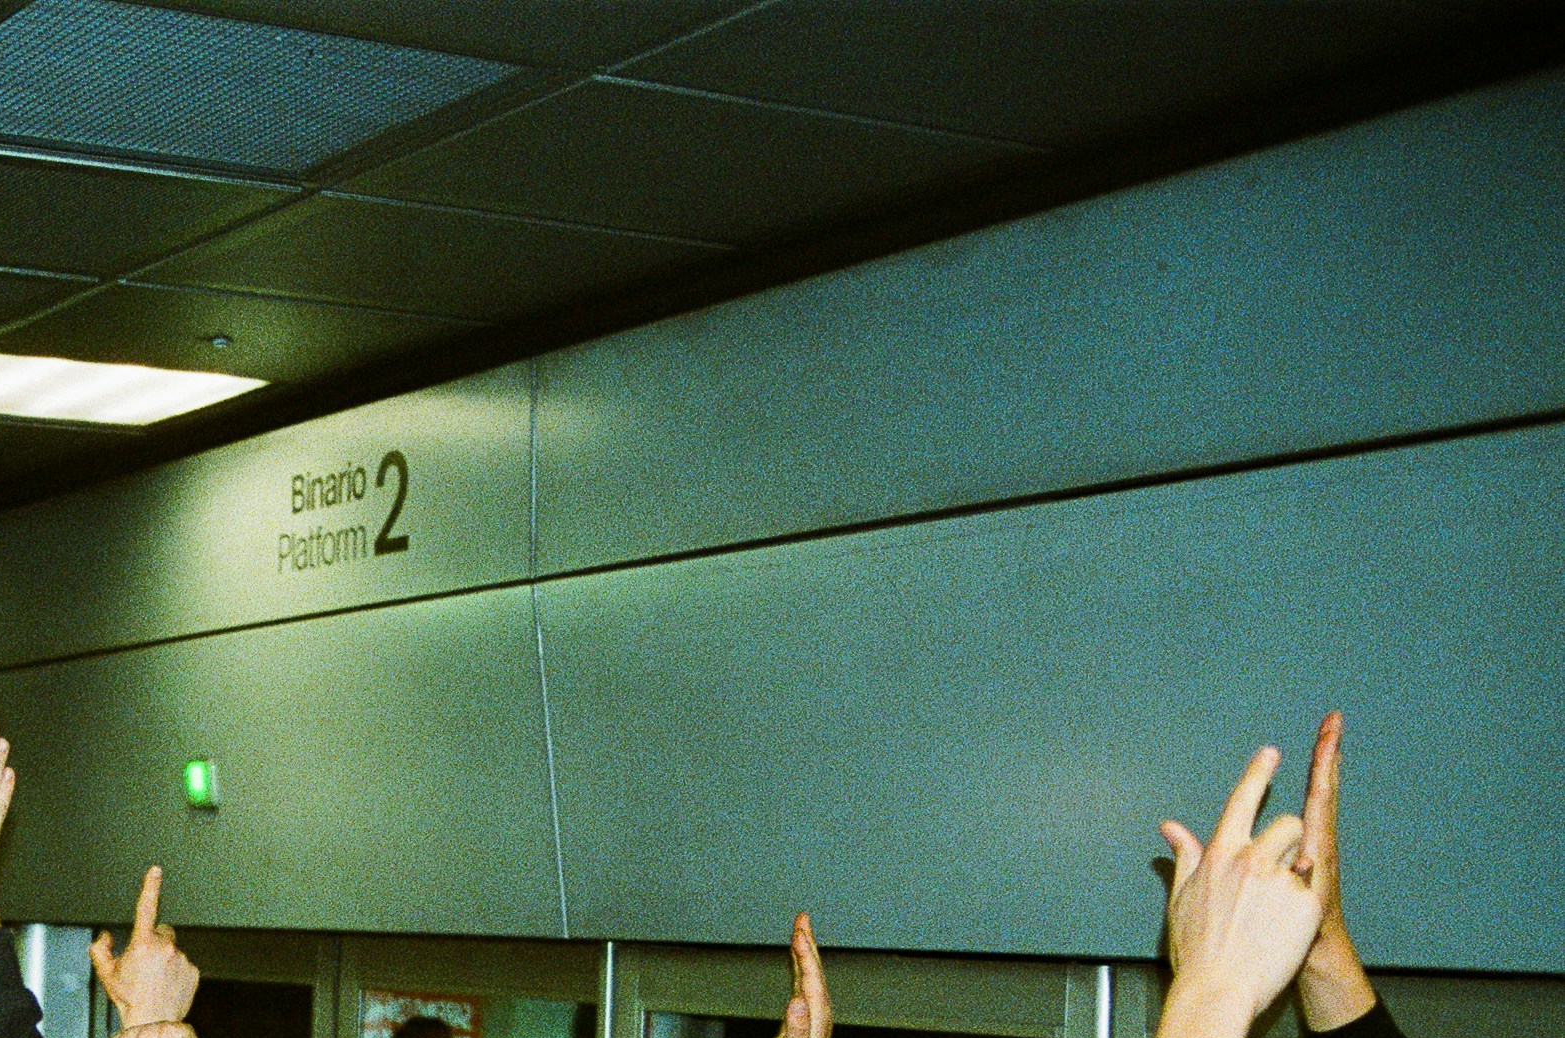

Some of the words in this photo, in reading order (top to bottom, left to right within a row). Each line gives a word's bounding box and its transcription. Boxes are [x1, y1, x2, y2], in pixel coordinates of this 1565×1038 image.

[290, 461, 368, 515] Binario
[373, 449, 411, 557] 2
[277, 524, 368, 575] Platform
